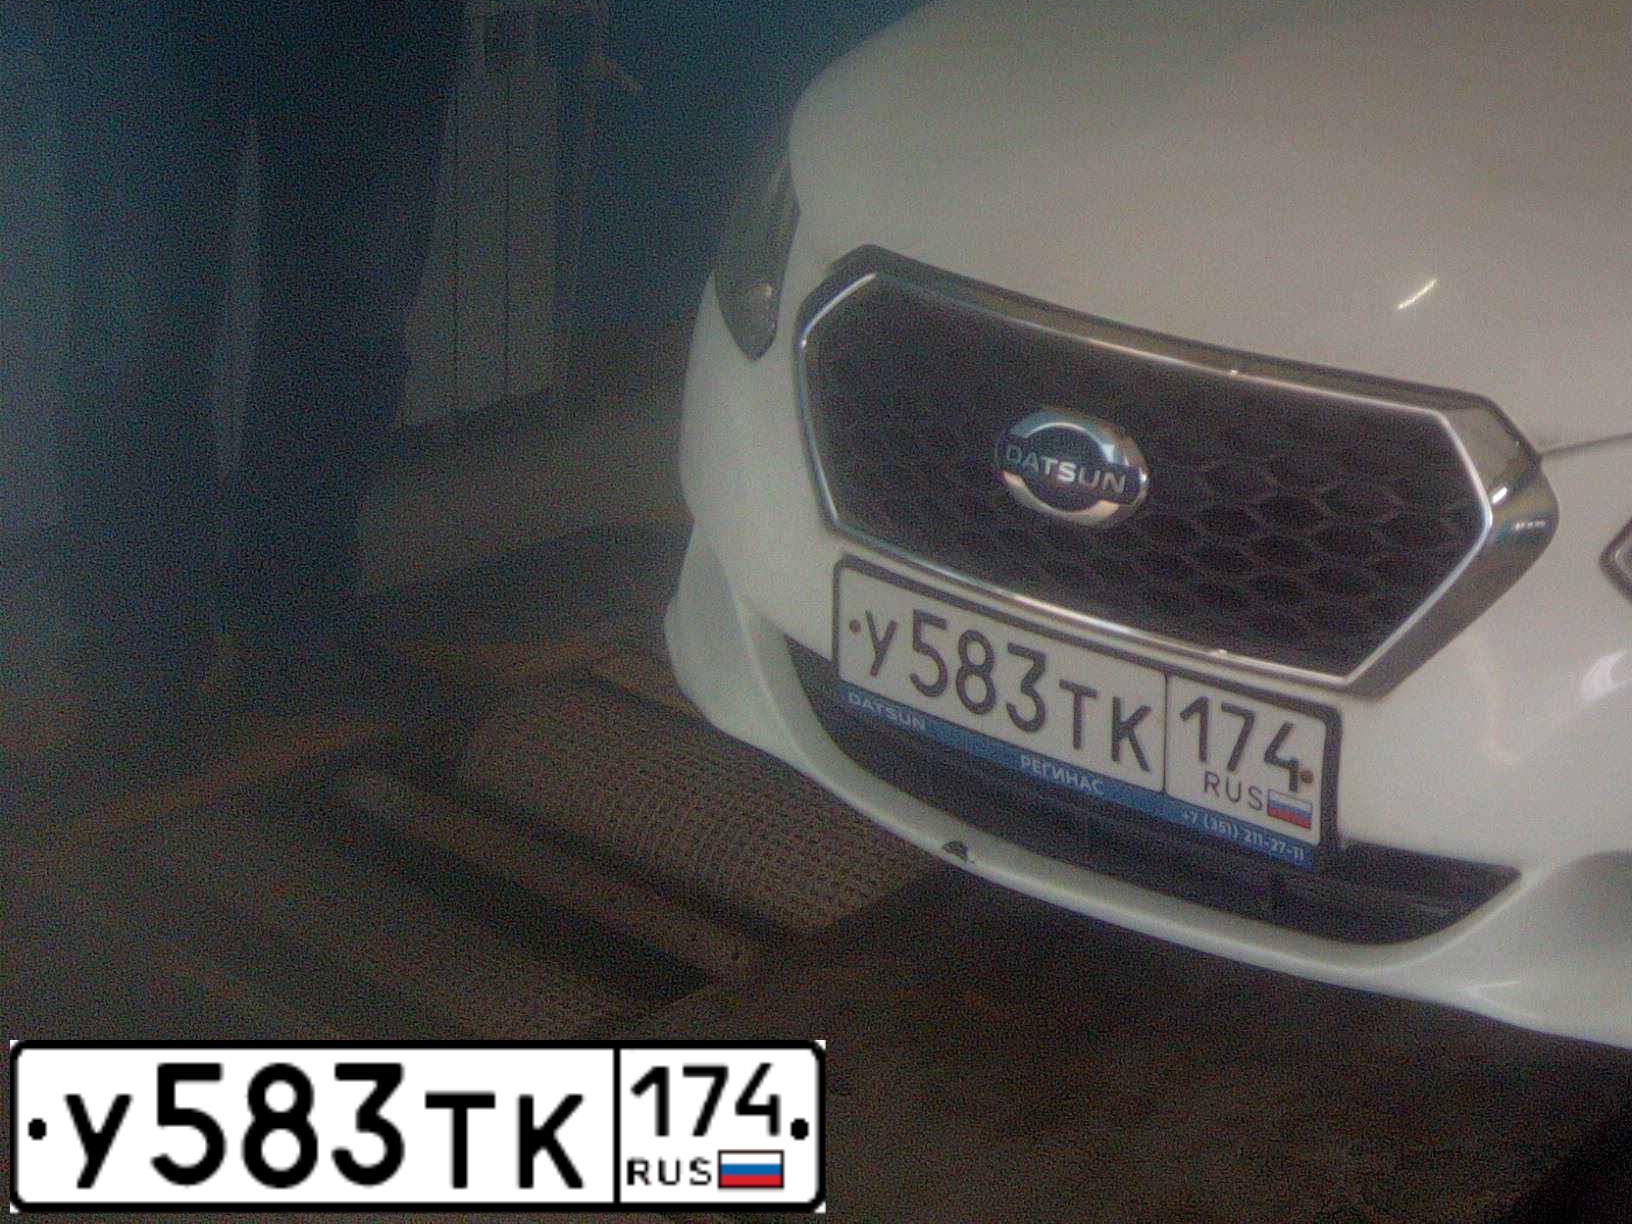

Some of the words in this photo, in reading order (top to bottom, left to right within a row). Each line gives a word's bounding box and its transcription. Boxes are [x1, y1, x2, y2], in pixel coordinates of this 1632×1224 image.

[1006, 443, 1127, 495] DATSUN
[848, 691, 928, 731] DATSUN
[1179, 694, 1300, 794] 174
[1020, 754, 1105, 795] РЕГИНАС
[1203, 771, 1265, 812] RUS
